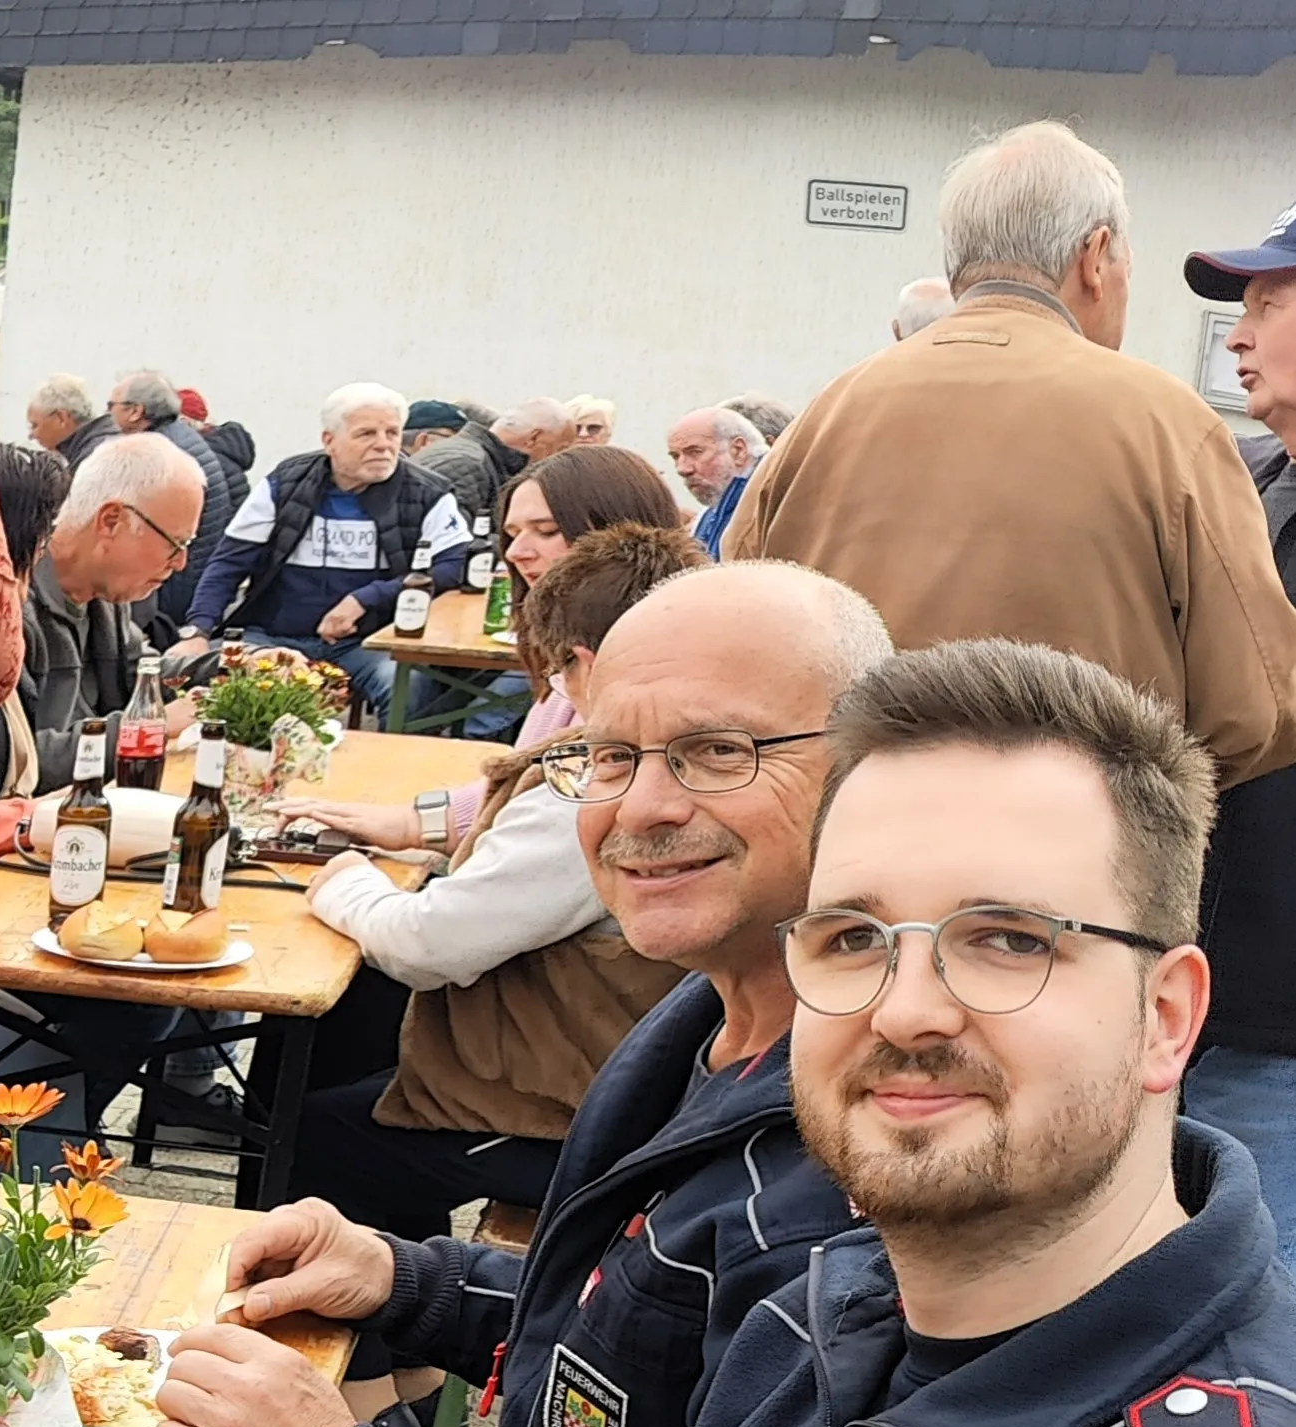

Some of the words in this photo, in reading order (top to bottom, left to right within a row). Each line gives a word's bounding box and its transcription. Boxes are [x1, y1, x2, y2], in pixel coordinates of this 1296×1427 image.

[815, 187, 902, 206] Ballspielen
[820, 204, 894, 222] verboten!
[558, 1360, 620, 1416] FEUERWEHR
